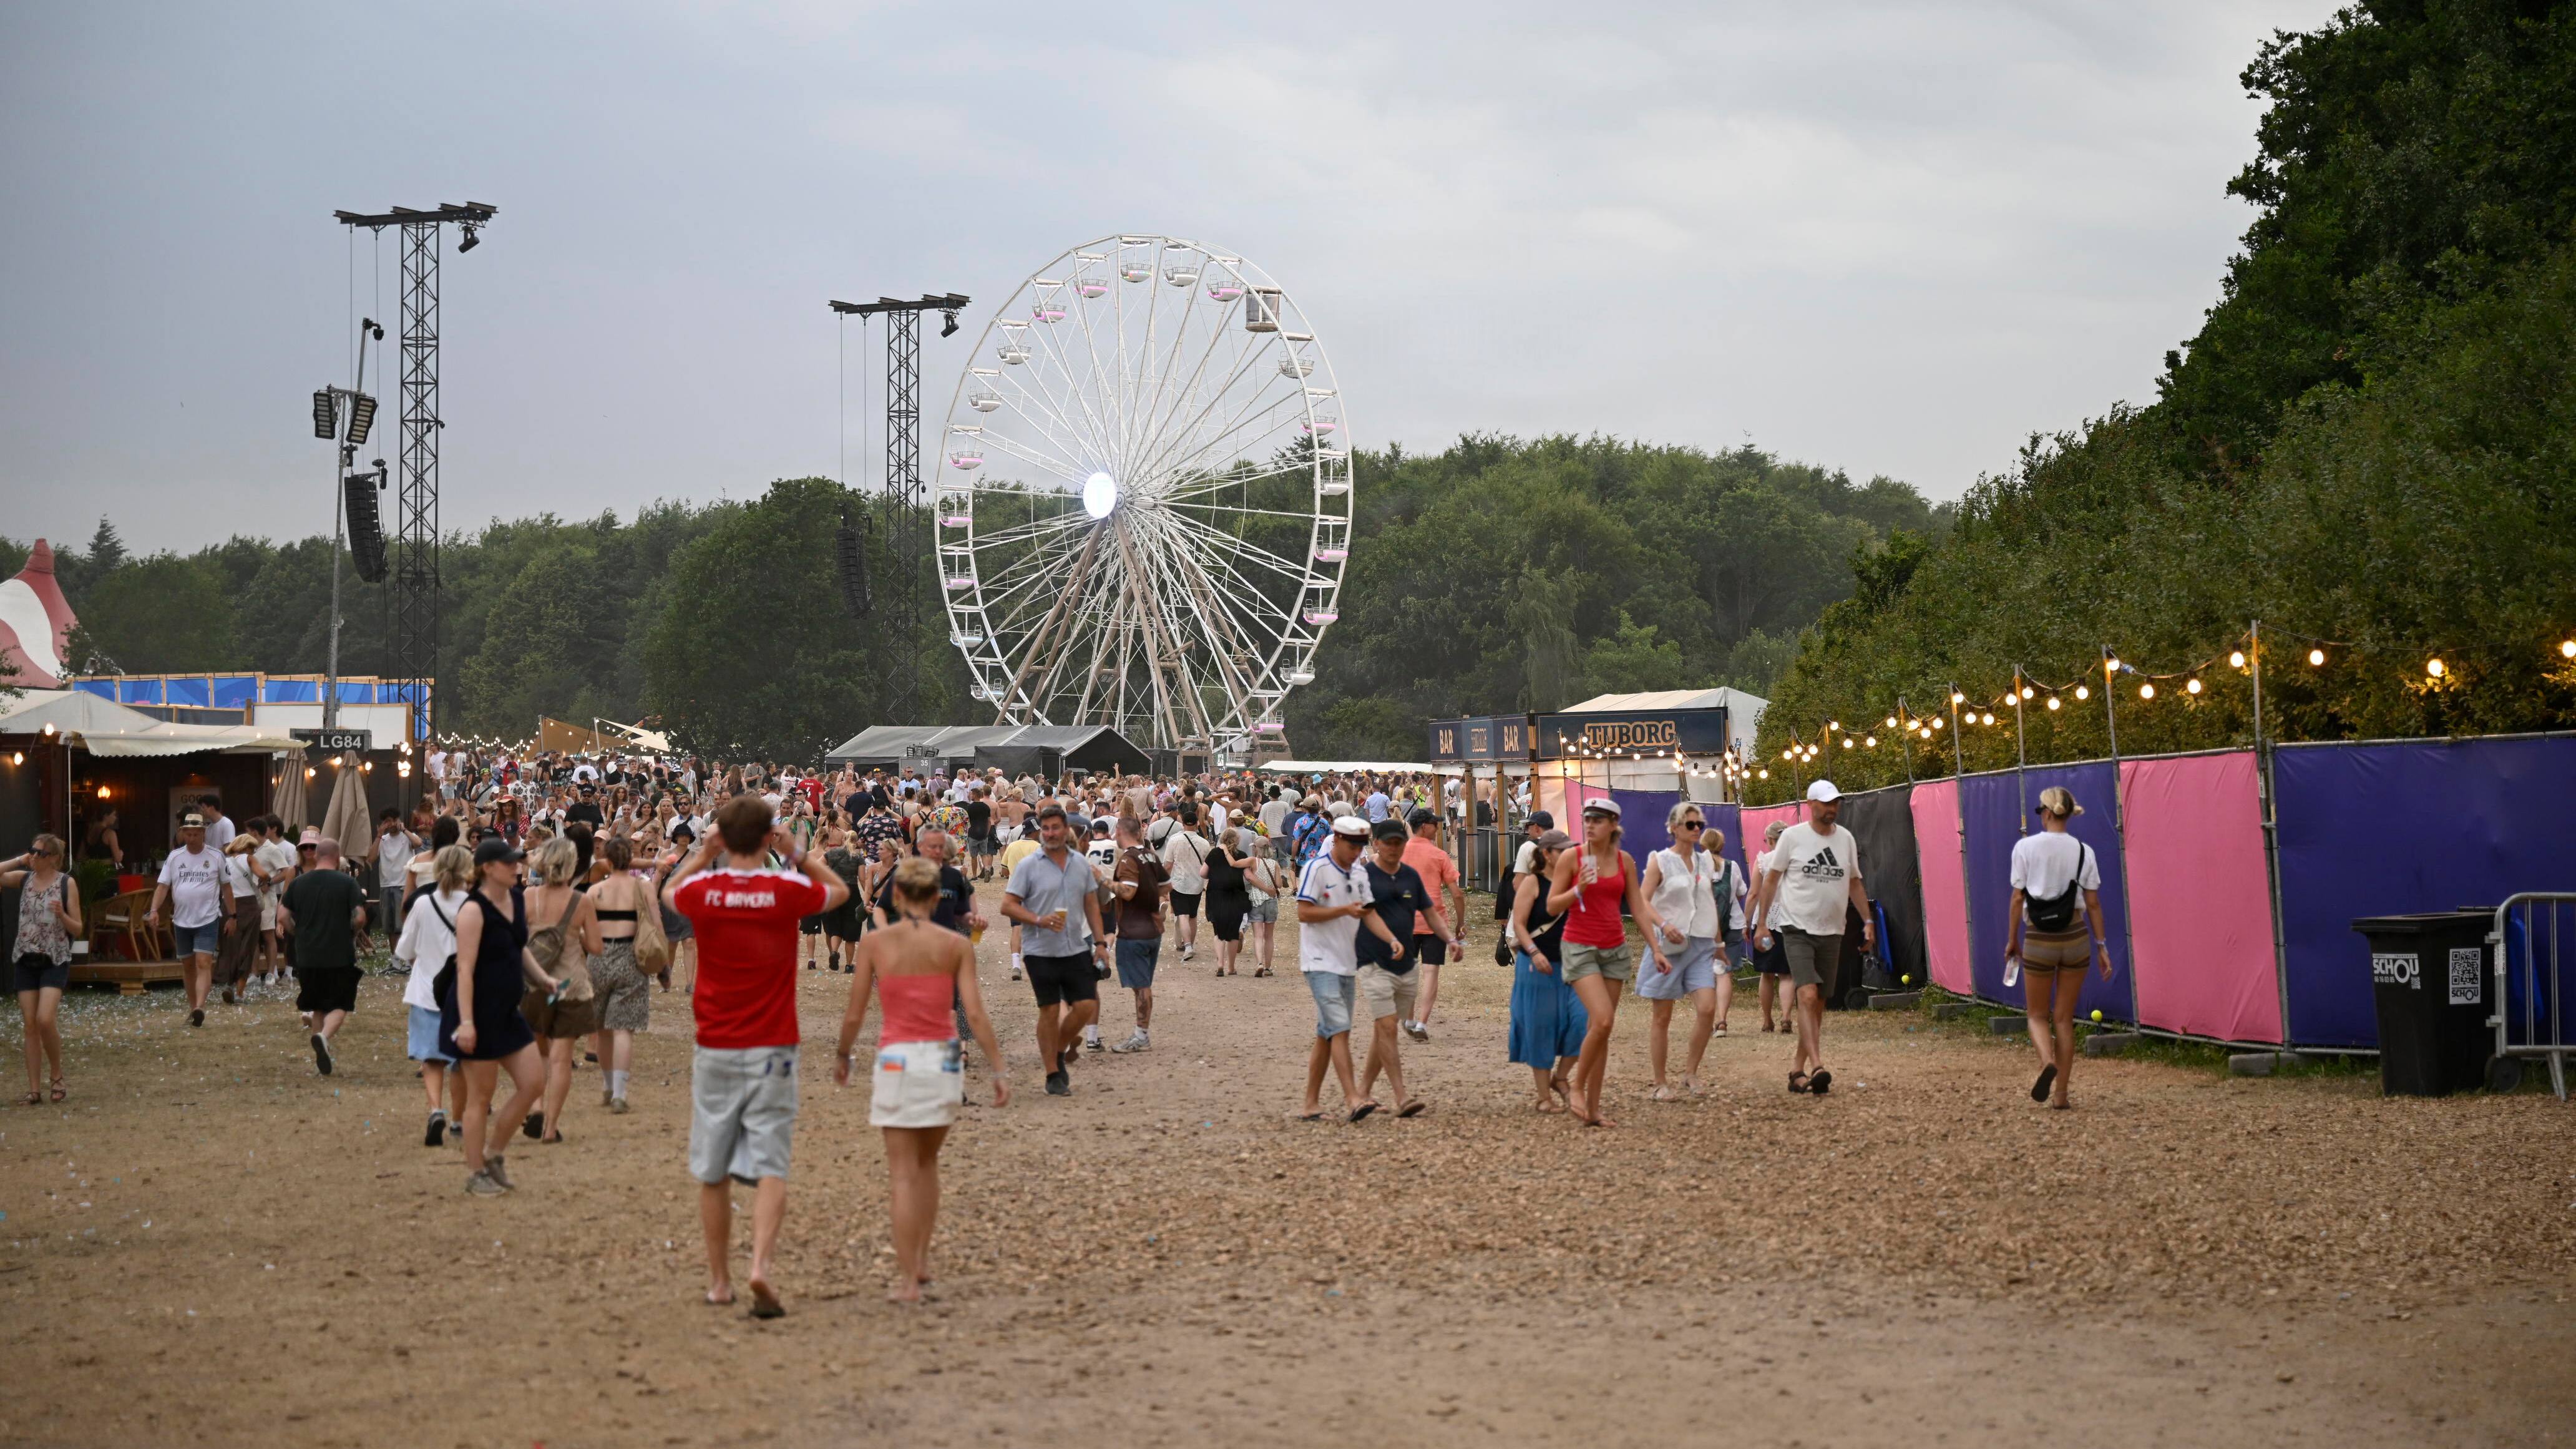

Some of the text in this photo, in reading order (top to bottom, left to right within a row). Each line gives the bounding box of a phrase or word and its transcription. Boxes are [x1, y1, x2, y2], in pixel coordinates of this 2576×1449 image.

[1439, 729, 1453, 754] BAR
[1504, 726, 1519, 752] BAR
[1587, 722, 1675, 746] TUBORG
[705, 890, 722, 907] FC
[2373, 959, 2419, 983] SCHOU
[2451, 988, 2479, 1001] SCHOU
